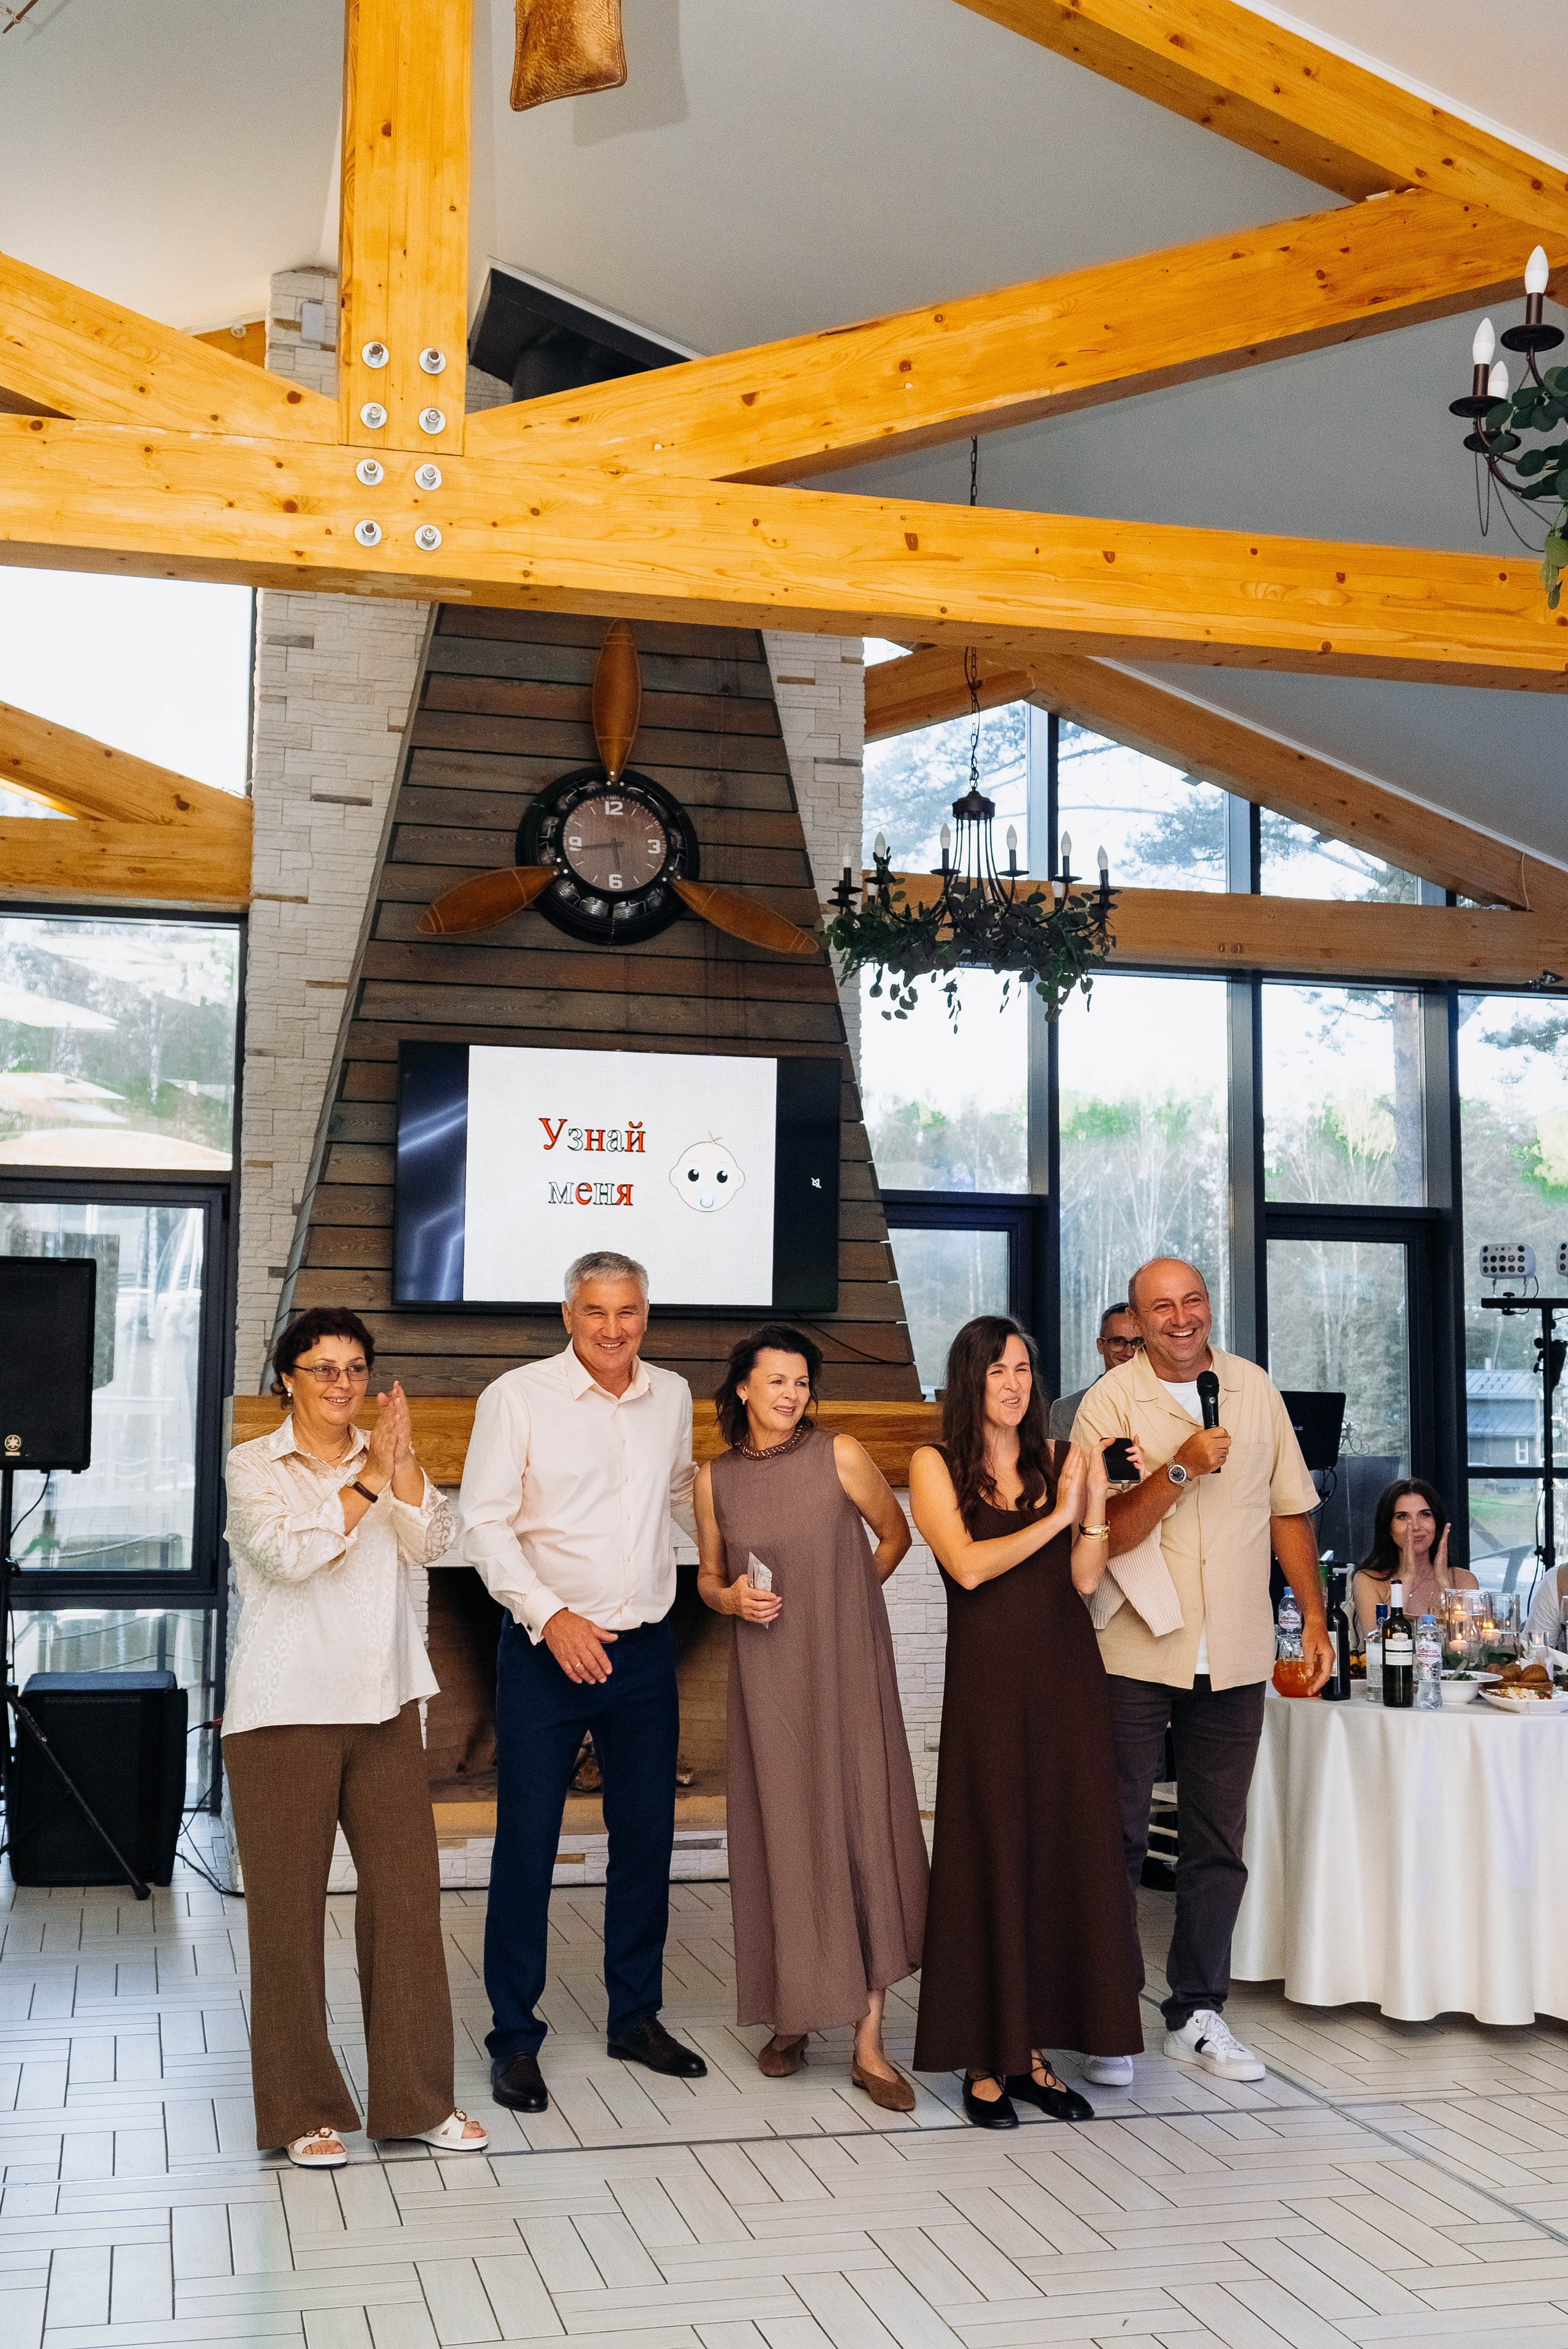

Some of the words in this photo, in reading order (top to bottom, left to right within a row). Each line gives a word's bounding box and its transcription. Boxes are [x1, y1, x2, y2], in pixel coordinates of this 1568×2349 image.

[605, 801, 624, 815] 12
[568, 836, 582, 851] 9
[647, 839, 661, 854] 3
[608, 874, 622, 889] 6
[538, 1117, 646, 1153] Узнай
[548, 1182, 634, 1206] меня
